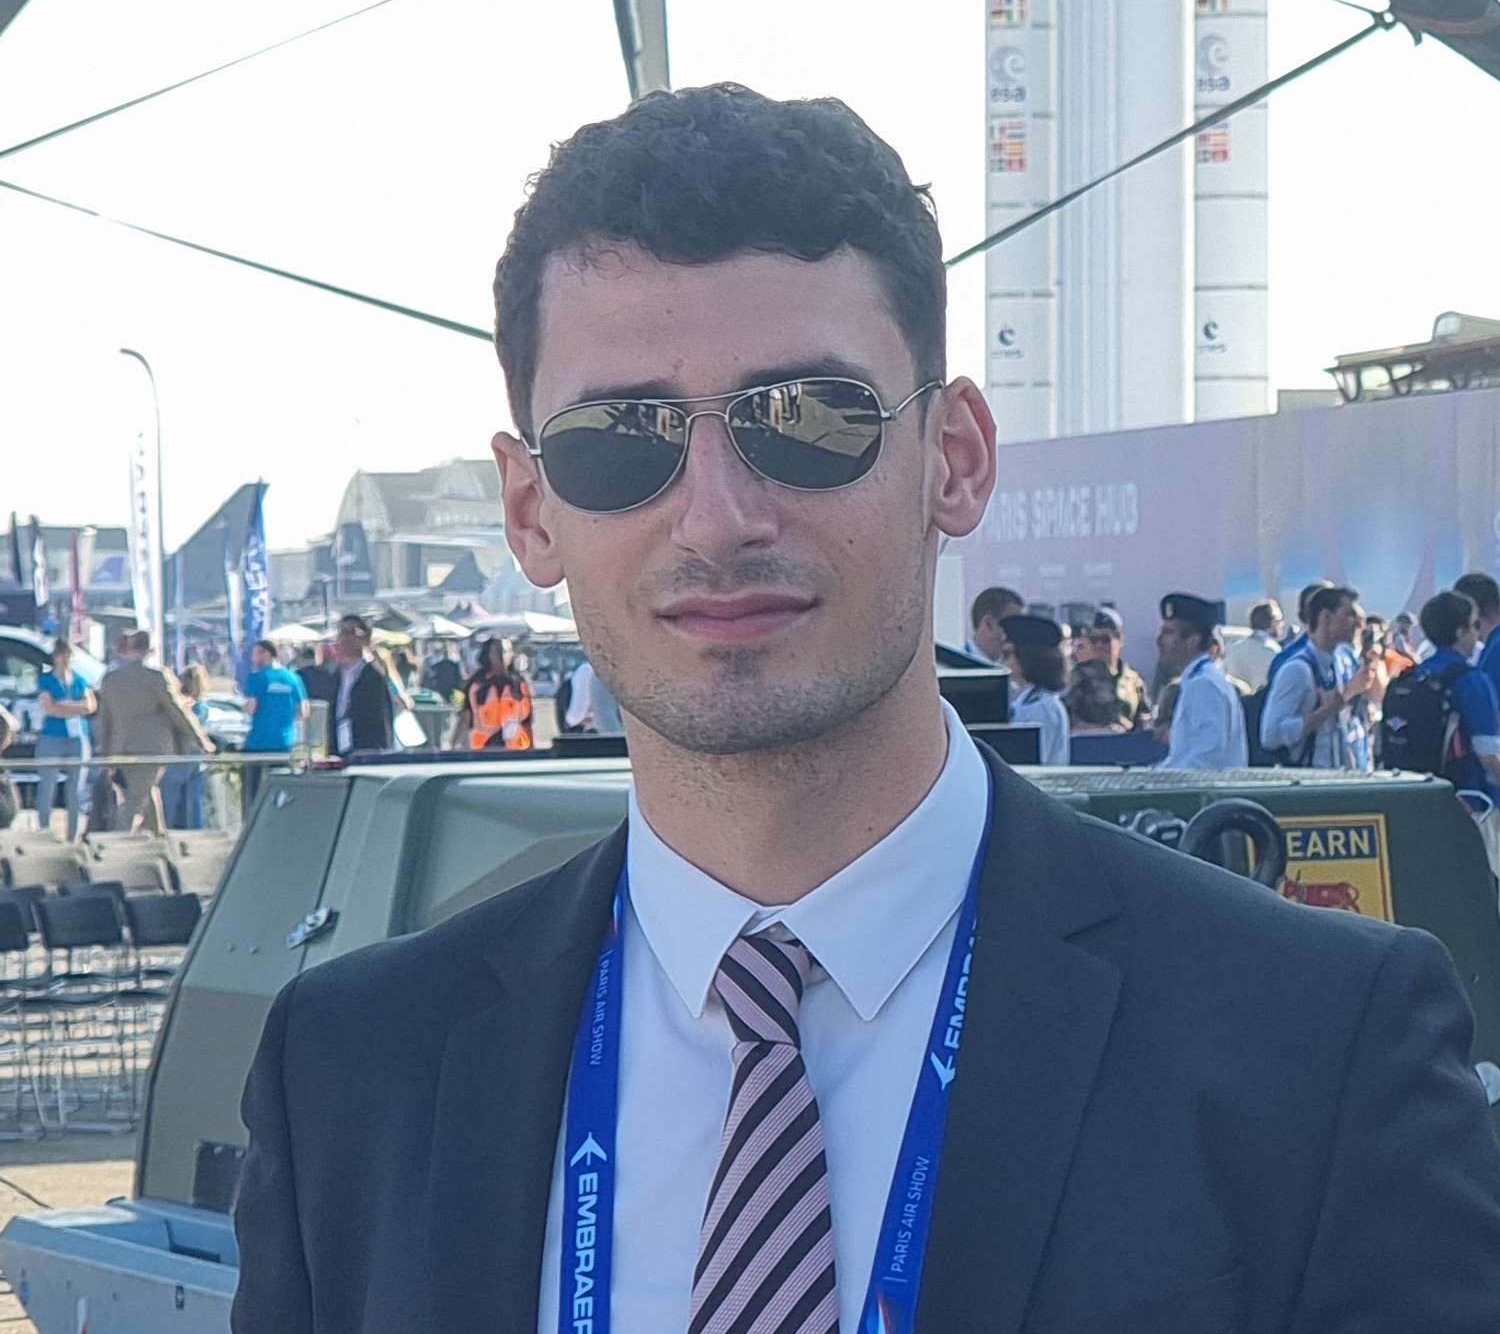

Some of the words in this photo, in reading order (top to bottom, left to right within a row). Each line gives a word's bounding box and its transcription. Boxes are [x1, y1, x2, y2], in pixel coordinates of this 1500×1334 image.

[1285, 828, 1371, 858] EARN
[589, 1024, 605, 1065] SHOW
[907, 1155, 931, 1202] SHOW
[901, 1202, 919, 1229] AIR
[890, 1230, 912, 1273] PARIS
